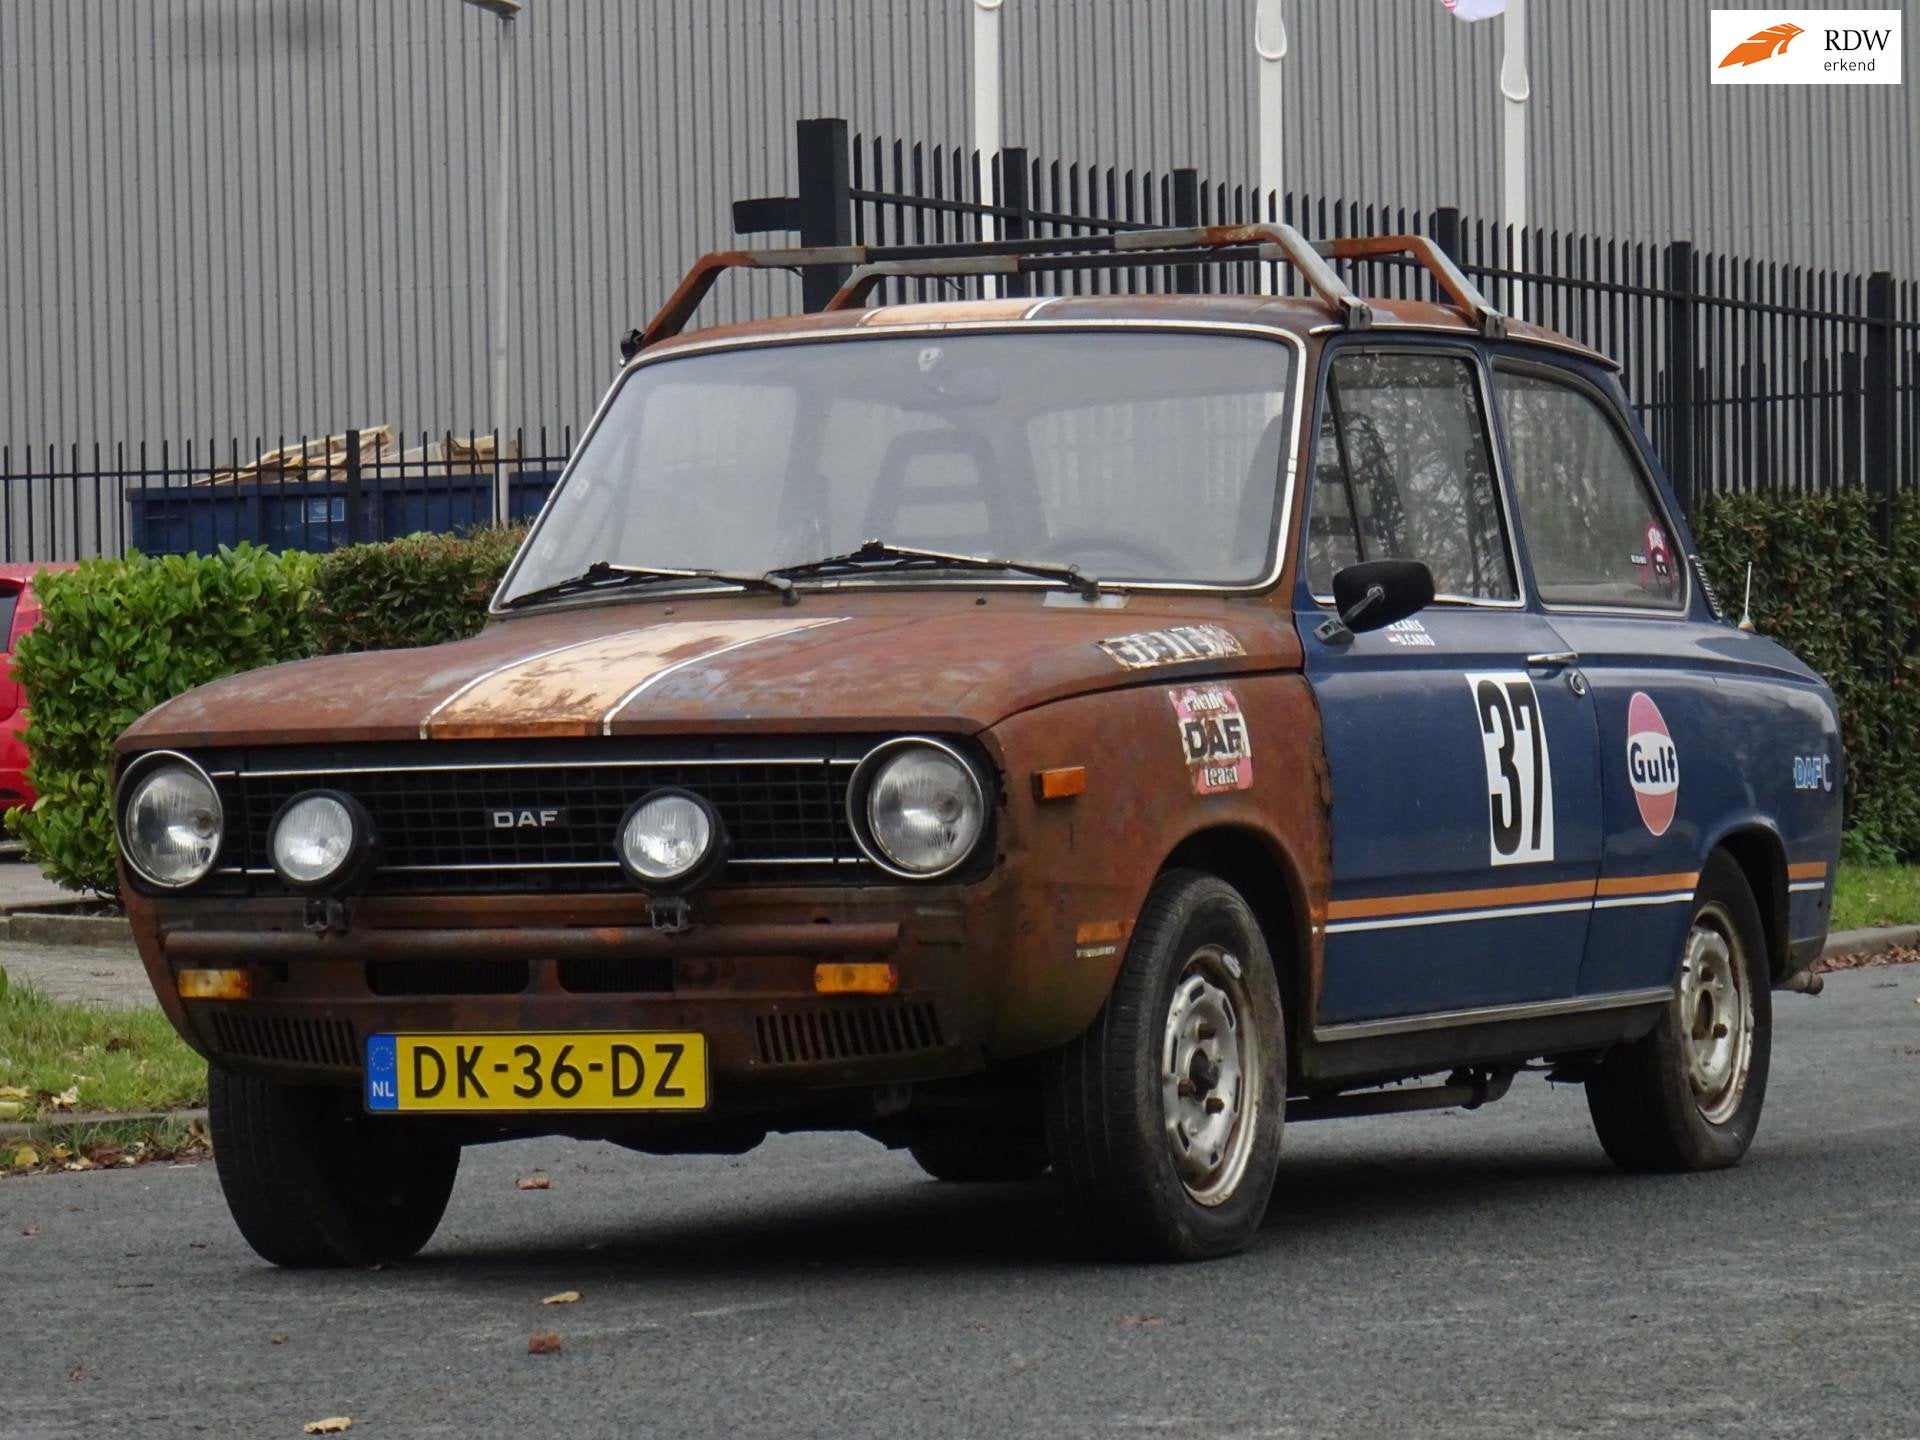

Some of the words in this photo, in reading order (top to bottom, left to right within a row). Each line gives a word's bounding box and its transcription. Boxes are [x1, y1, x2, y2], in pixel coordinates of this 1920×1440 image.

[1184, 717, 1242, 759] DAF
[1476, 679, 1544, 856] 37
[1629, 741, 1677, 785] Gulf
[492, 810, 558, 828] DAF
[372, 1081, 395, 1098] NL
[412, 1043, 686, 1099] DK-36-DZ
